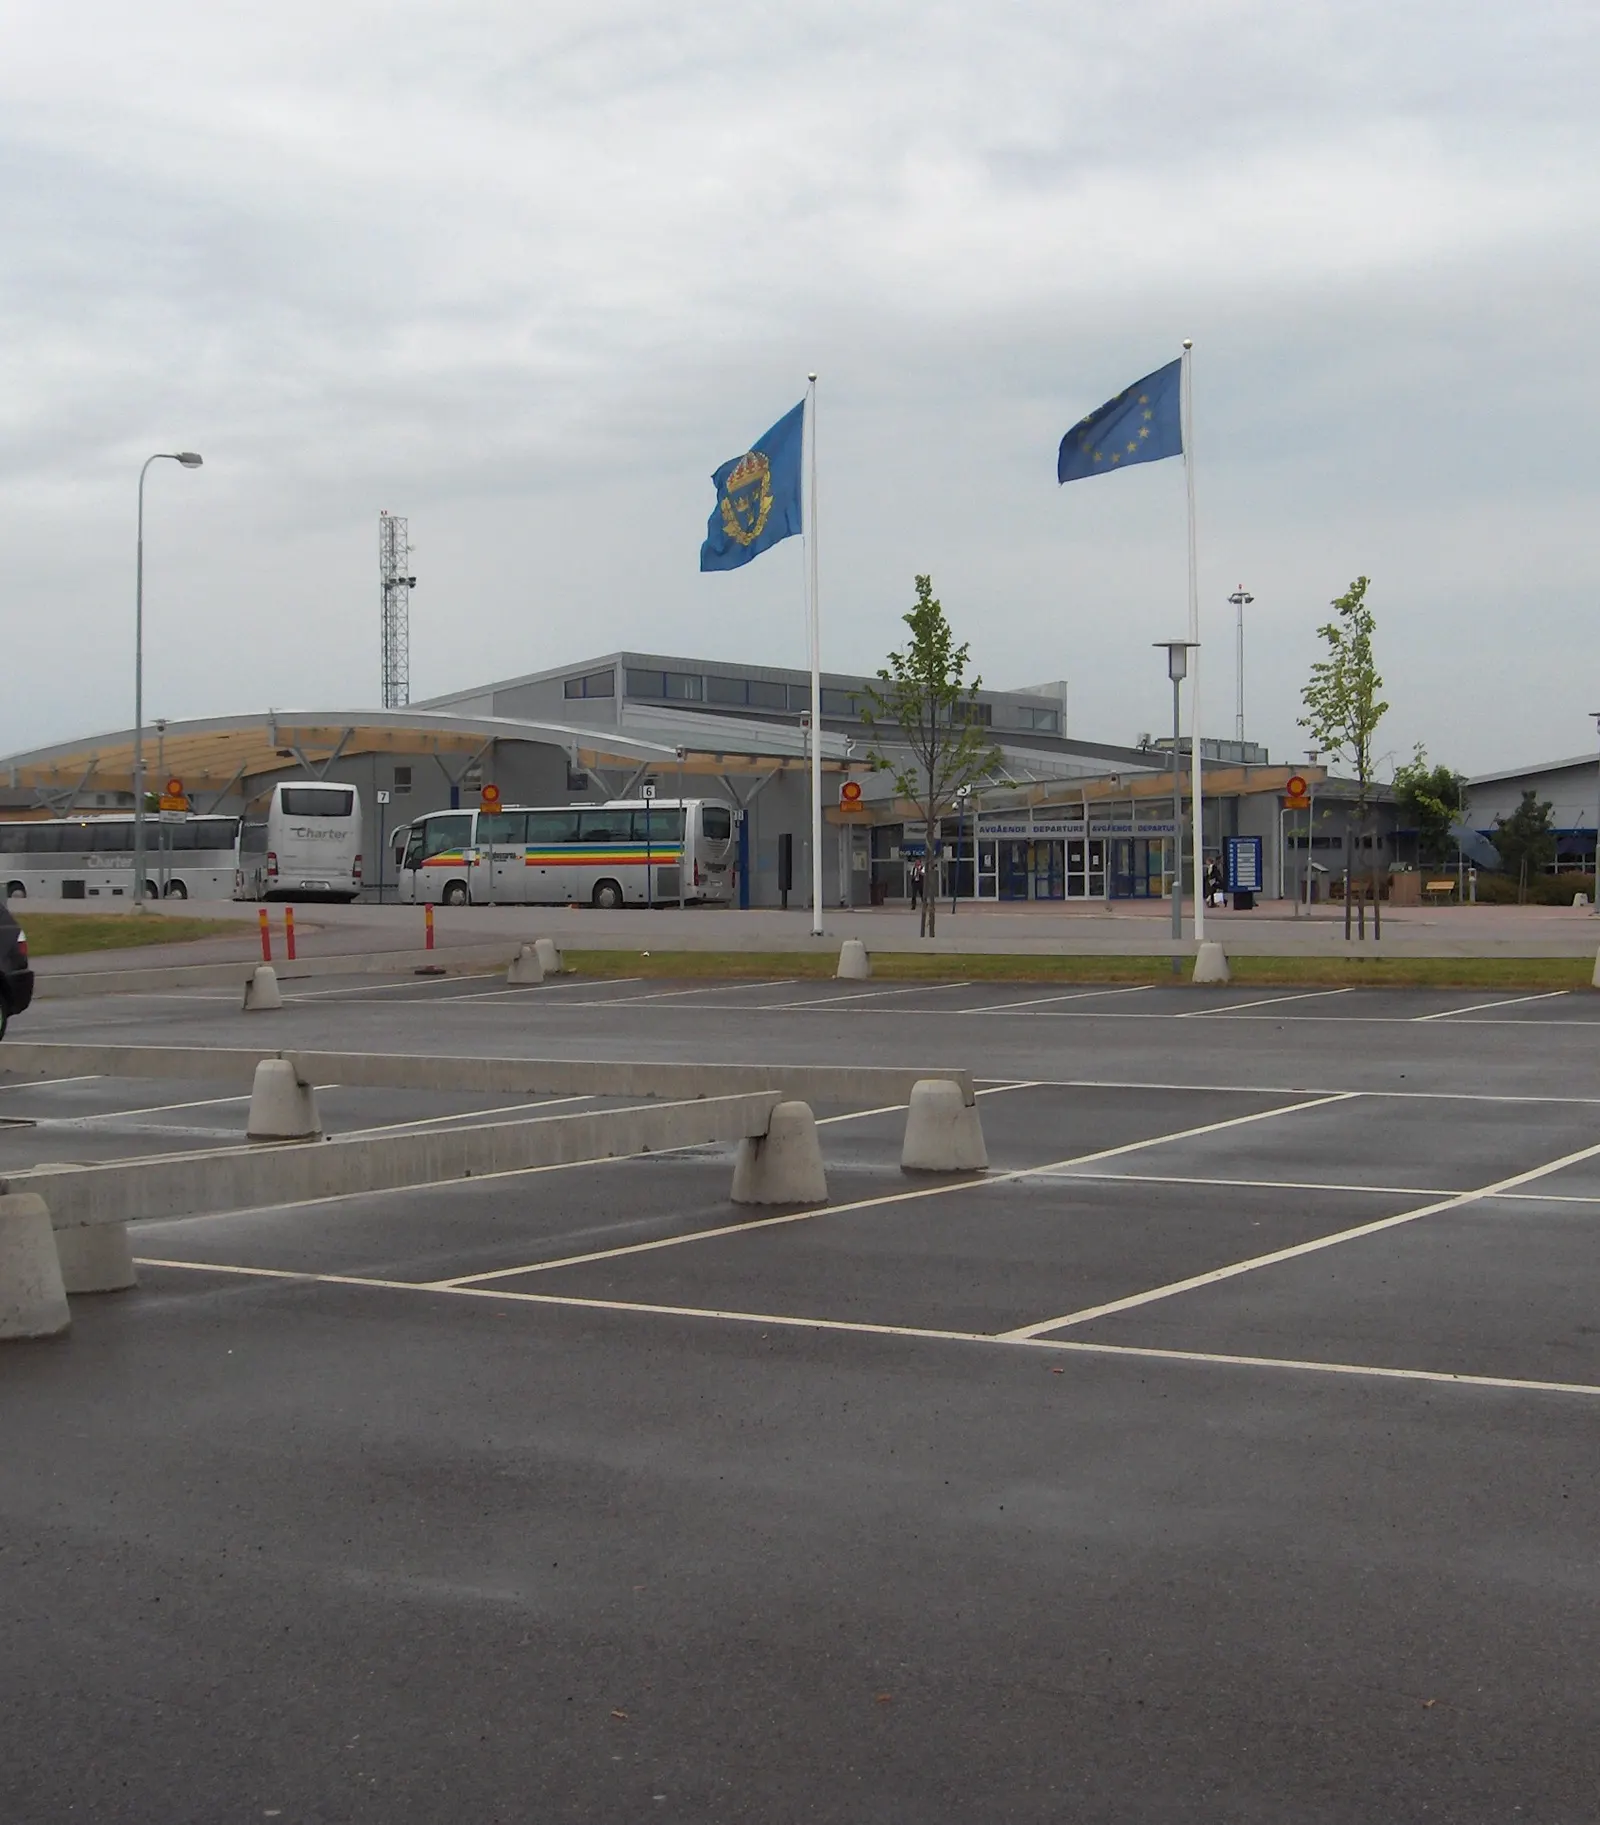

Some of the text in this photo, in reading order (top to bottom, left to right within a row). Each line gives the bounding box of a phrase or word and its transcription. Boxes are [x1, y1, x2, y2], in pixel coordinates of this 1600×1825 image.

[646, 787, 652, 796] 6
[380, 792, 387, 801] 7
[290, 827, 347, 839] Charter
[979, 825, 1084, 833] AVGÅENDE DEPARTURE
